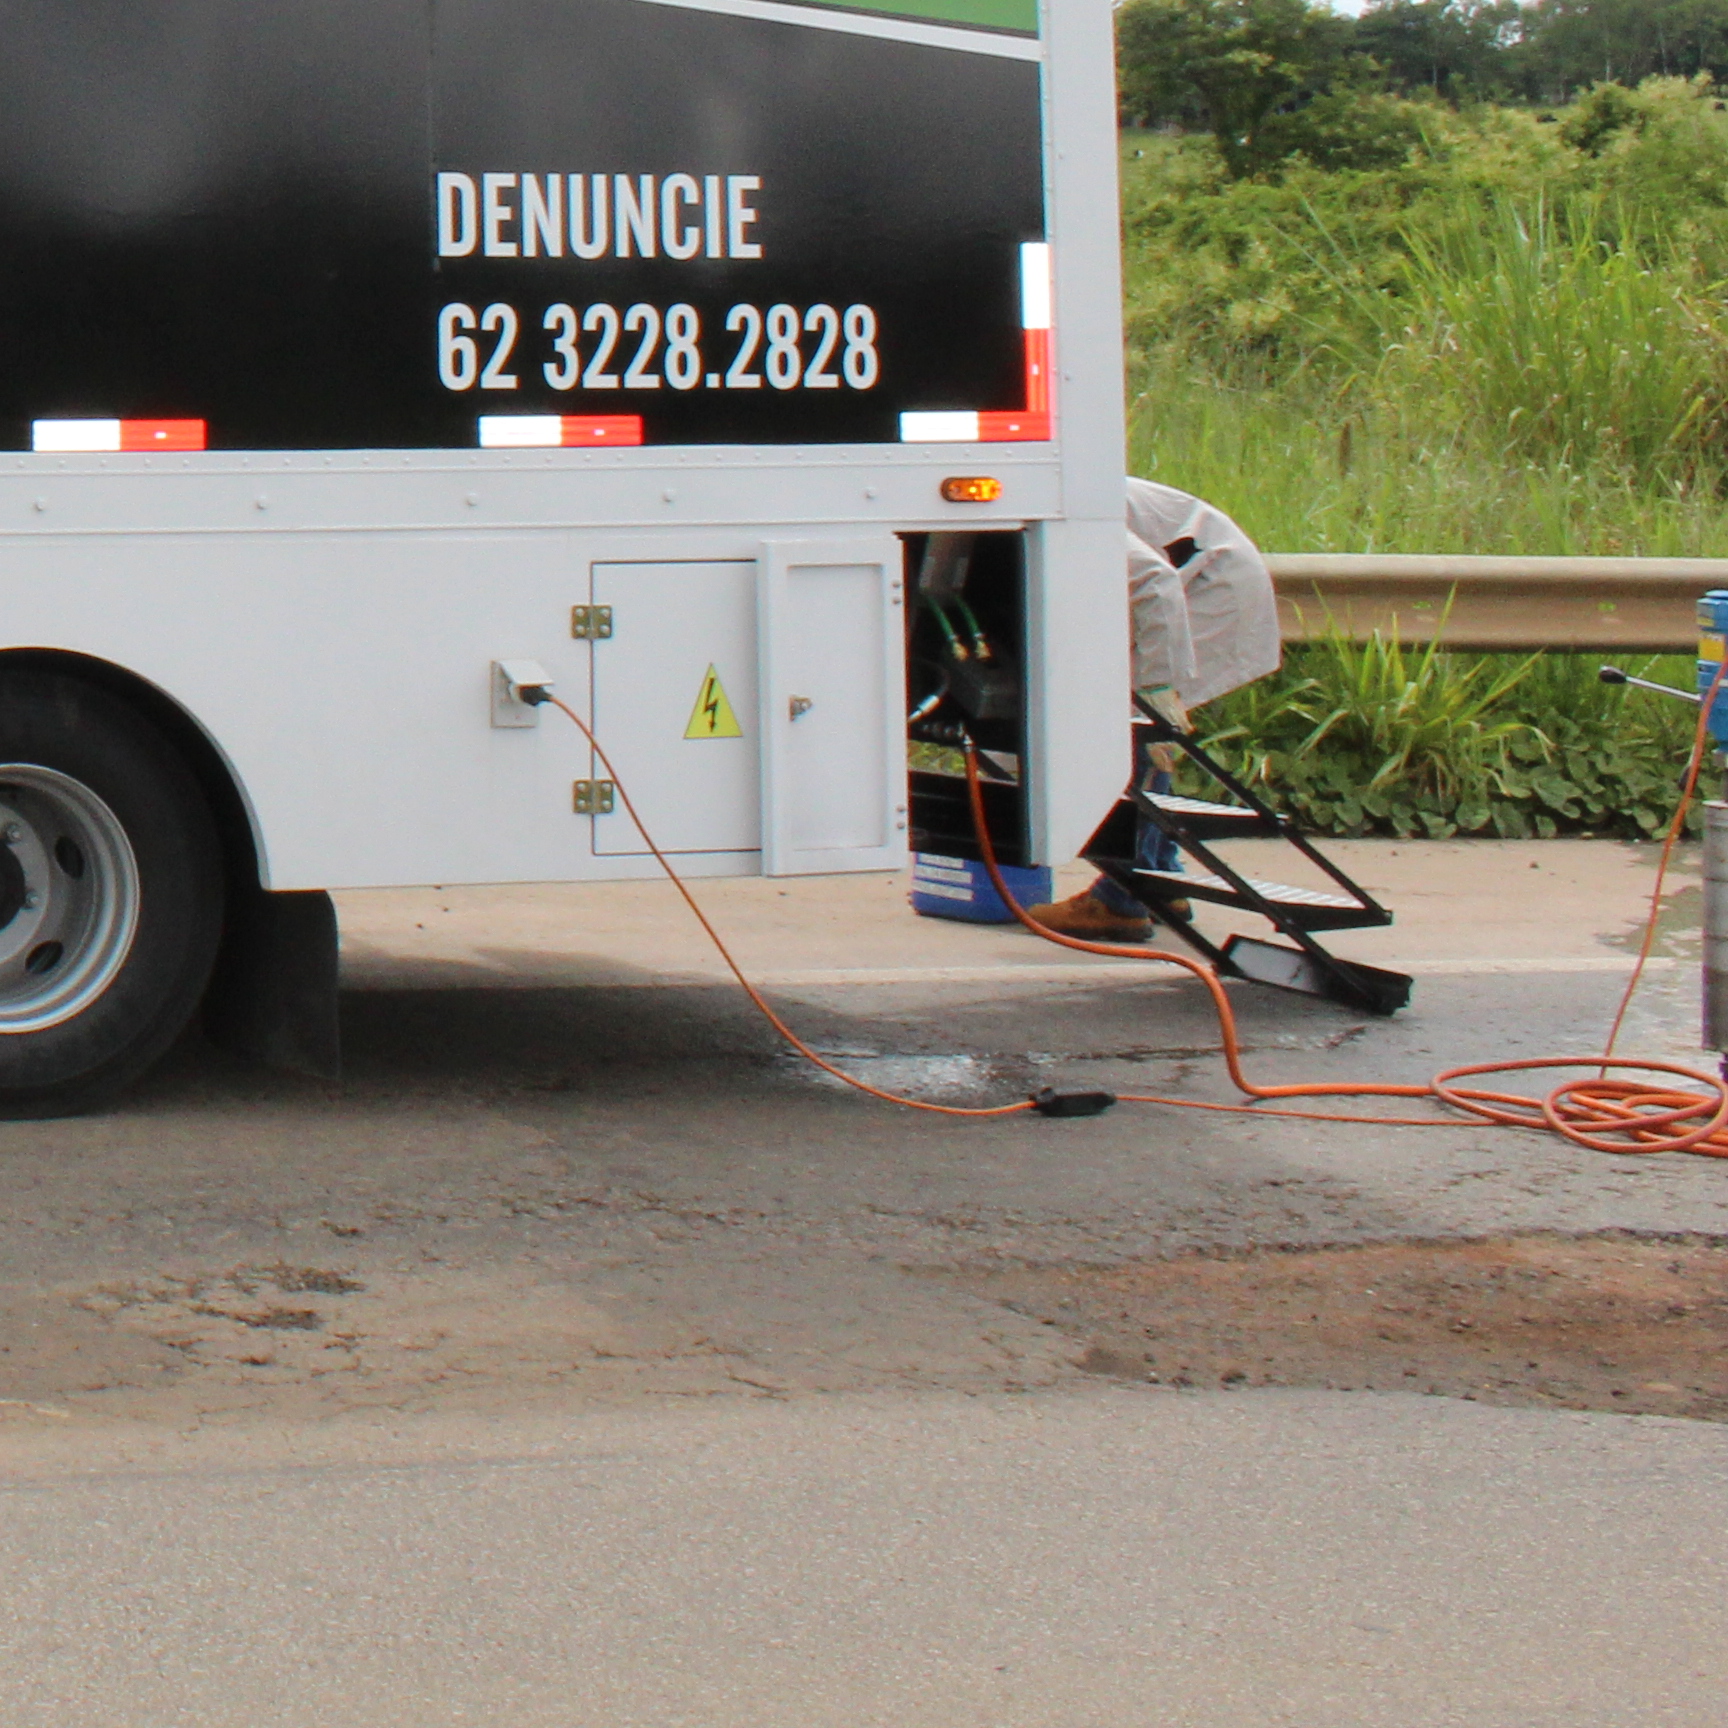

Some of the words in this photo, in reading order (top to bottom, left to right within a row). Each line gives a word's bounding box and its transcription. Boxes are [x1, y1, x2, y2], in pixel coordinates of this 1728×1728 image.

[437, 171, 763, 261] DENUNCIE
[438, 302, 519, 391] 62
[542, 302, 880, 391] 3228.2828
